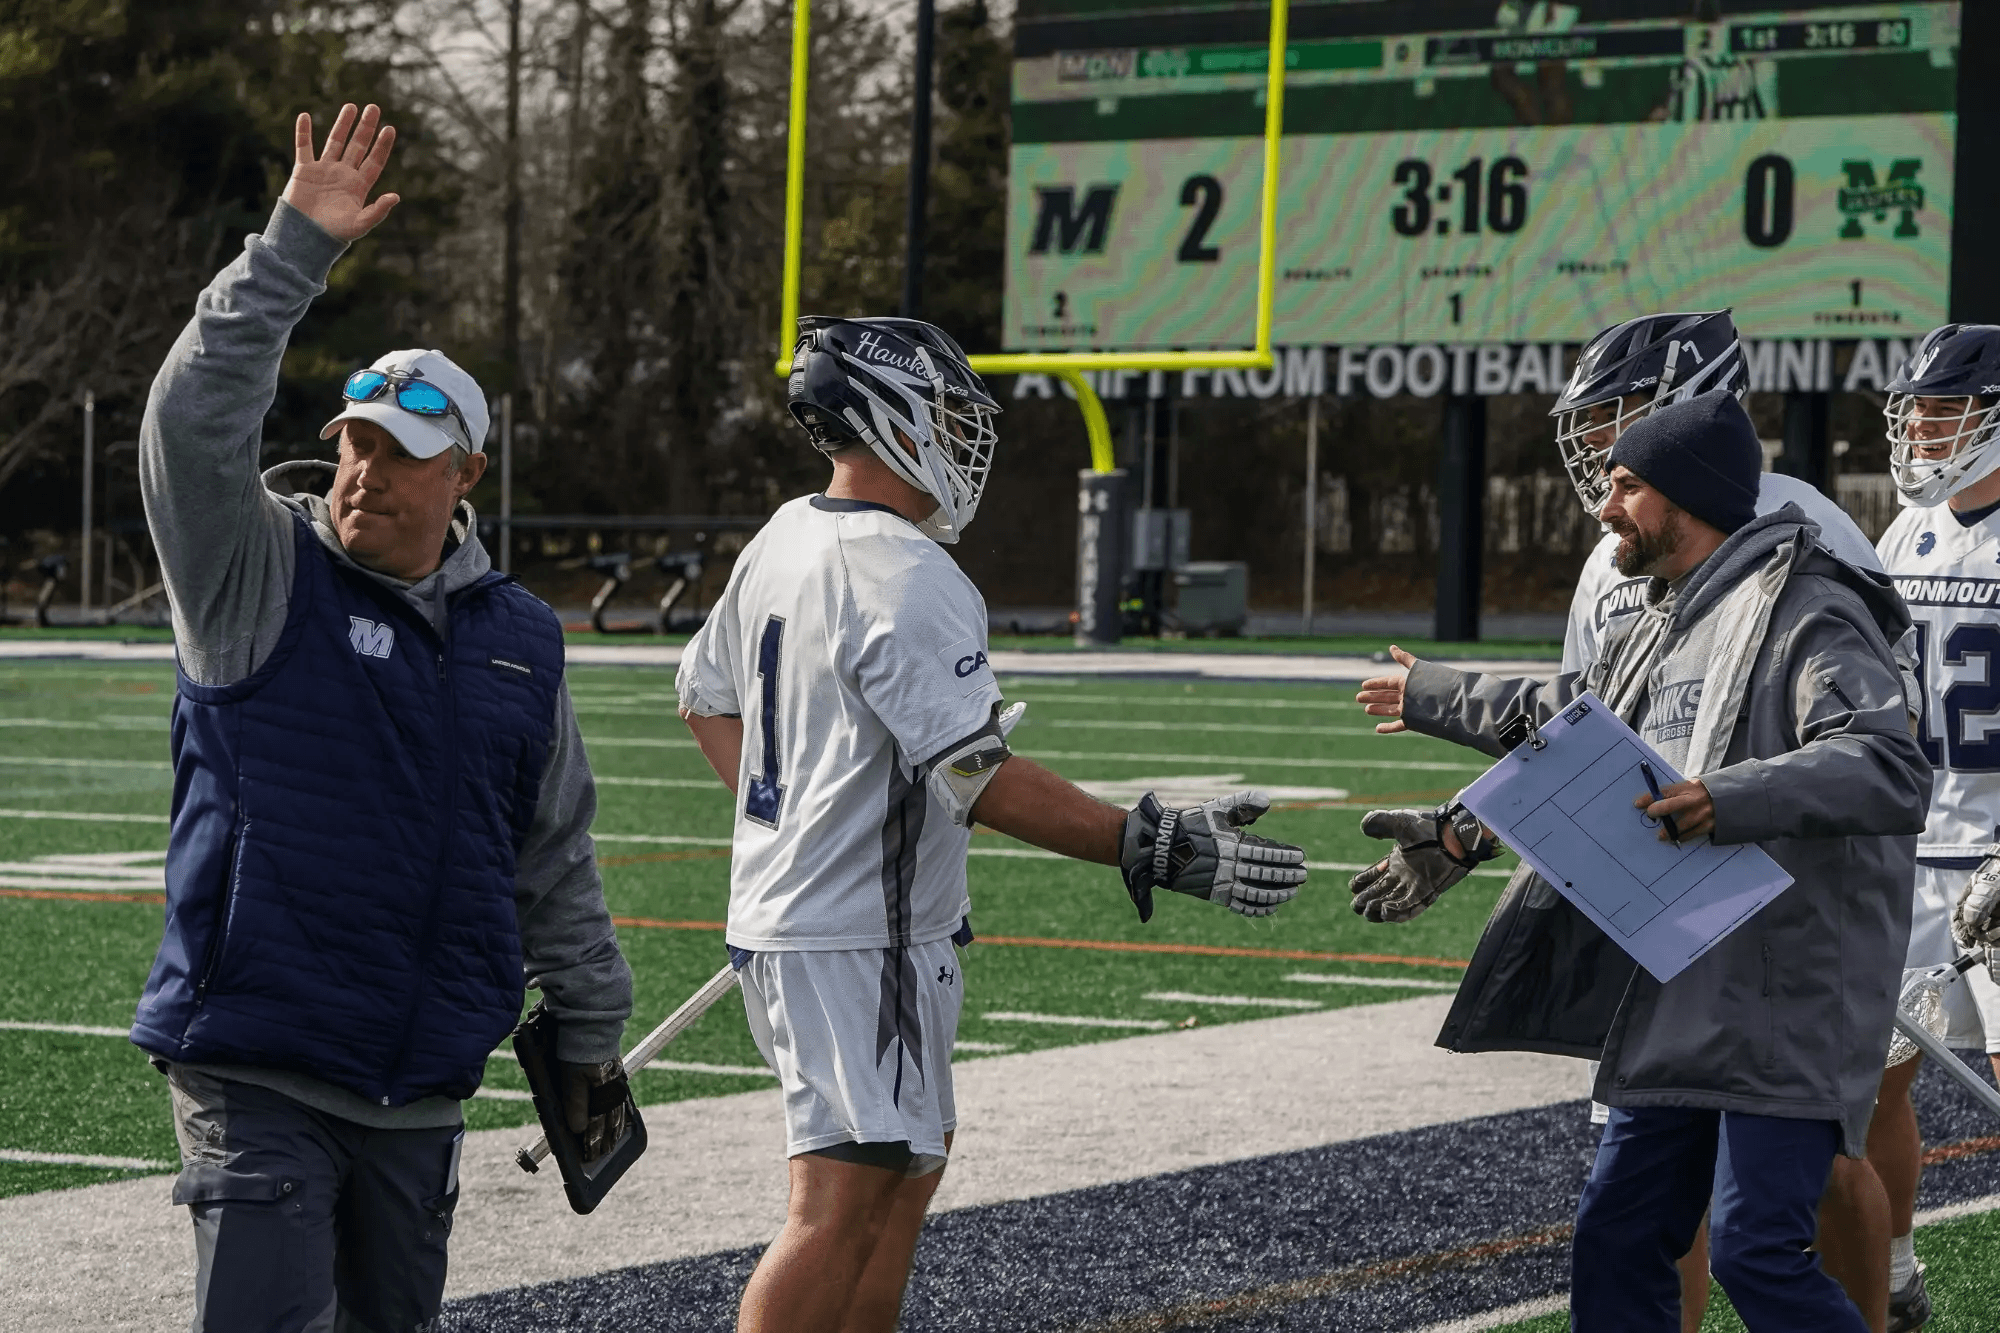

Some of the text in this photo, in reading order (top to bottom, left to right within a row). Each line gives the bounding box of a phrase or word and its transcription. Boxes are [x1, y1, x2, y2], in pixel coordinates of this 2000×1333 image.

[1804, 24, 1857, 47] 3:16
[1030, 184, 1121, 255] M
[1178, 174, 1225, 263] 2
[1392, 157, 1528, 236] 3:16
[1745, 153, 1795, 248] 0
[1449, 293, 1462, 326] 1
[1850, 278, 1862, 307] 1
[1181, 349, 1325, 398] FROM
[1336, 344, 1572, 398] FOOTBAL
[1894, 579, 2000, 604] MONMOU
[349, 615, 394, 659] M
[744, 613, 788, 831] 1
[1982, 873, 1999, 882] 16
